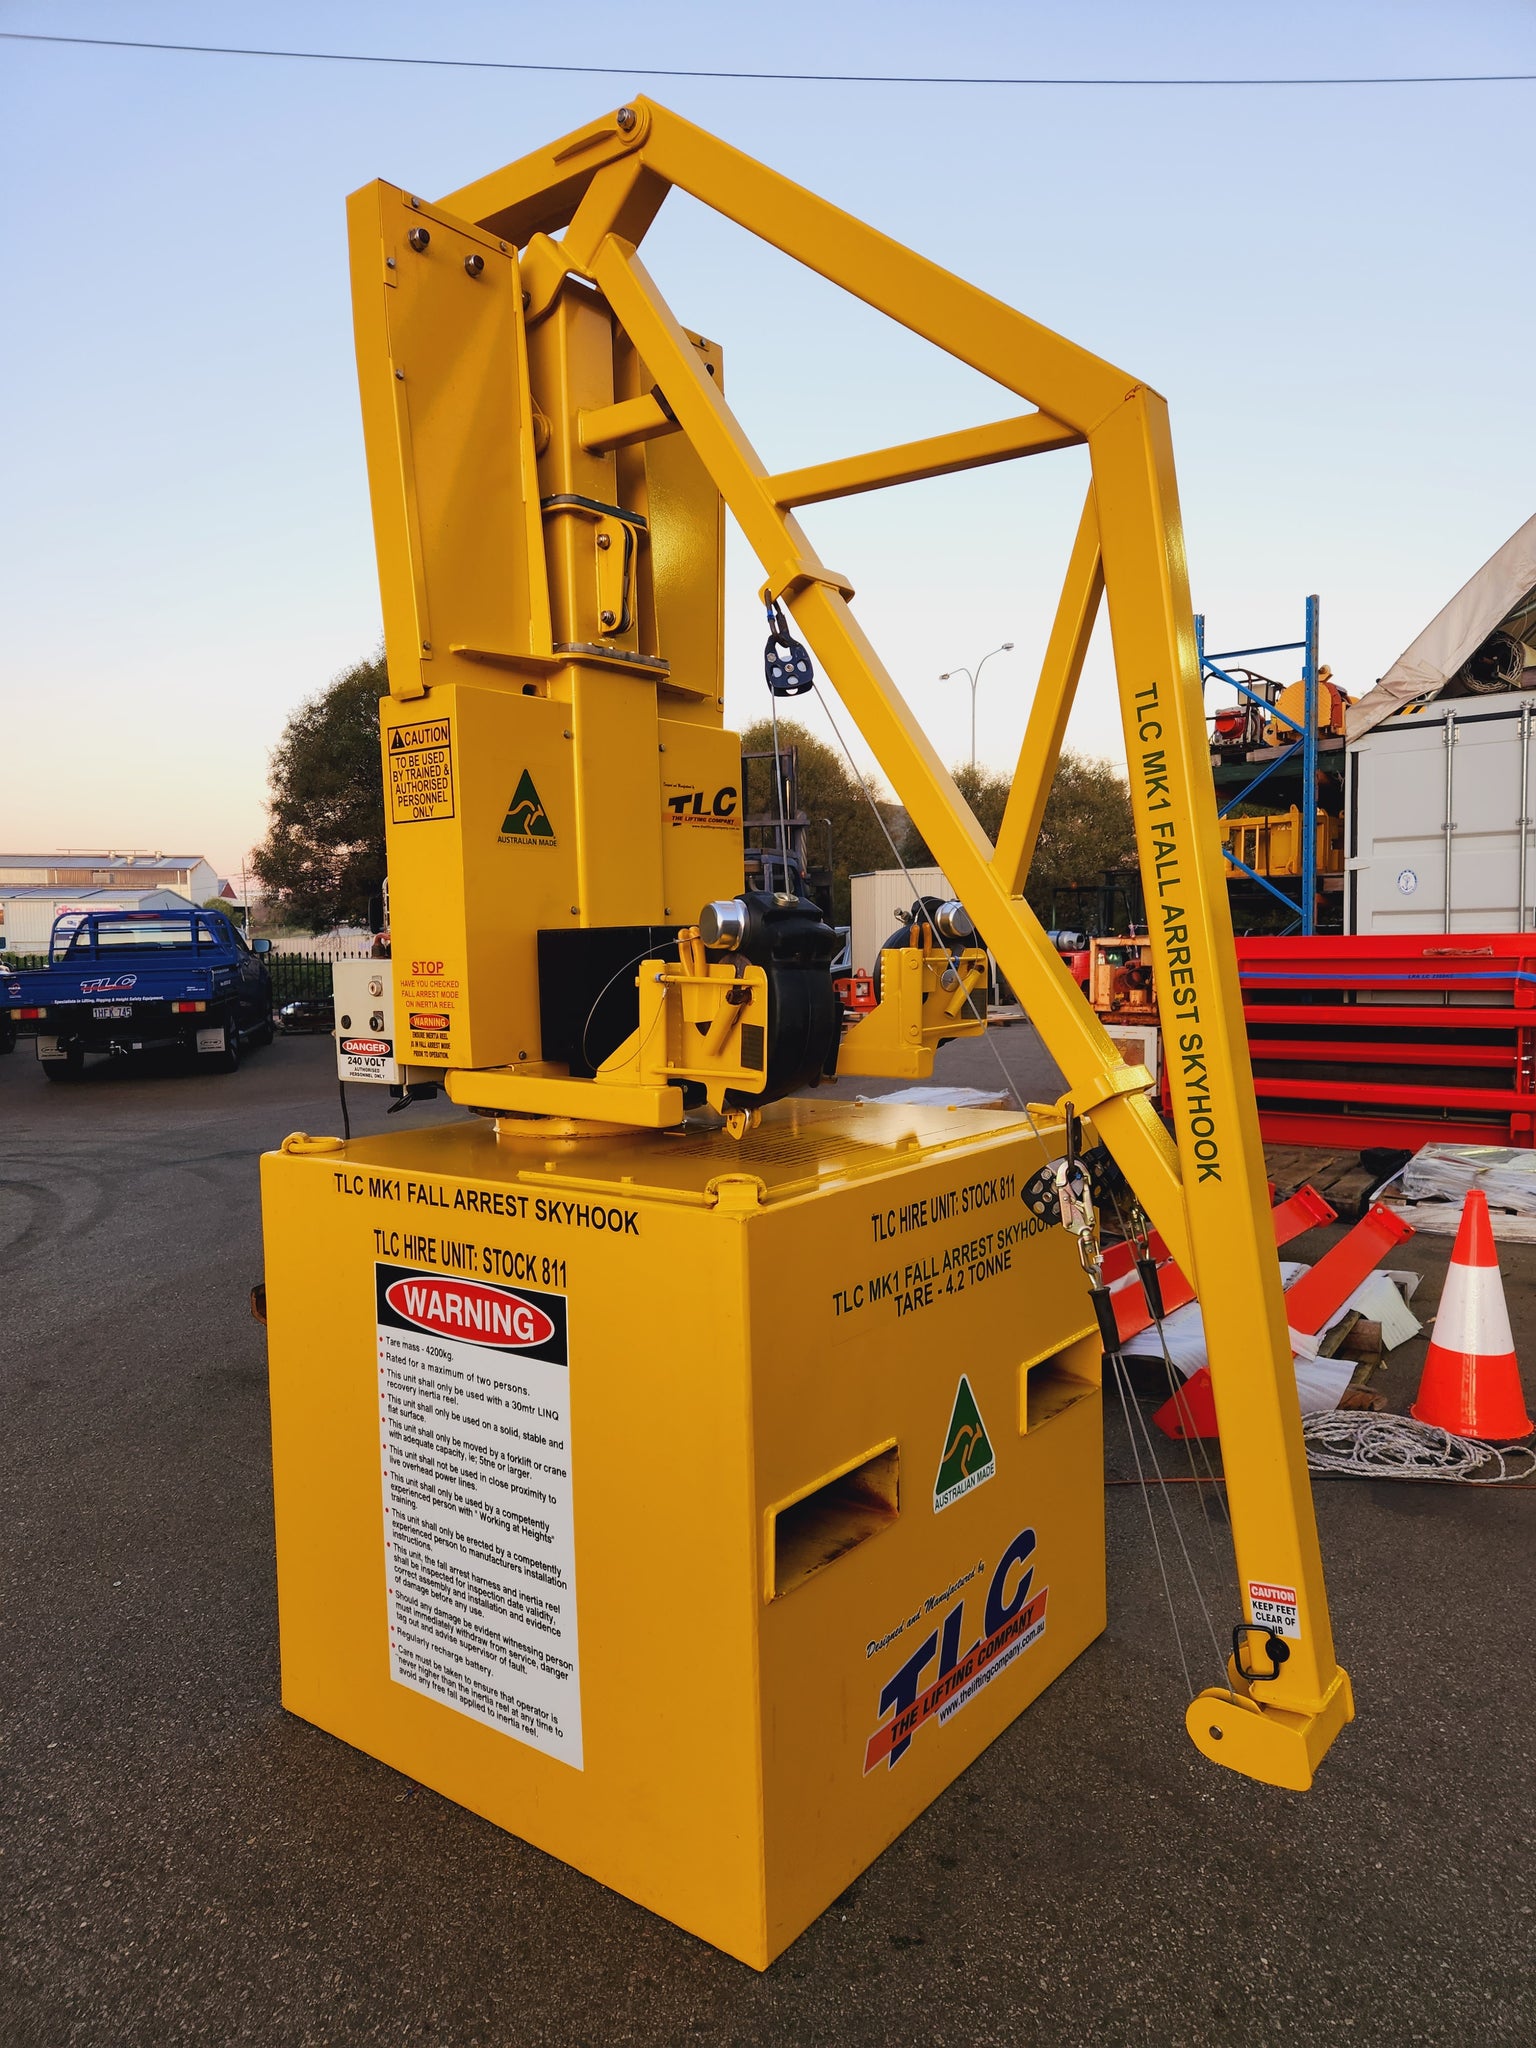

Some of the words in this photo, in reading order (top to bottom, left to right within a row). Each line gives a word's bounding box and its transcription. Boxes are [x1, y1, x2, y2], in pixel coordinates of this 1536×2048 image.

[1135, 682, 1163, 742] TLC
[405, 726, 448, 746] CAUTION
[393, 770, 403, 782] BY
[406, 765, 441, 781] TRAINED
[444, 764, 450, 775] &
[396, 757, 406, 768] TO
[409, 755, 419, 767] BE
[422, 752, 444, 765] USED
[1142, 750, 1172, 811] MK1
[396, 778, 448, 794] AUTHORISED
[398, 791, 448, 807] PERSONNEL
[668, 787, 737, 826] TLC
[413, 805, 434, 818] ONLY
[498, 836, 537, 845] AUSTRALIAN
[539, 838, 557, 847] MADE
[1151, 822, 1181, 897] FALL
[80, 974, 137, 994] TLC
[412, 962, 444, 973] STOP
[1161, 905, 1200, 1023] ARREST
[413, 1017, 446, 1027] WARNING
[346, 1042, 386, 1052] DANGER
[348, 1057, 362, 1065] 240
[364, 1058, 386, 1067] VOLT
[1179, 1034, 1222, 1183] SKYHOOK
[334, 1173, 363, 1196] TLC
[369, 1178, 401, 1201] MK1
[408, 1182, 449, 1208] FALL
[454, 1189, 528, 1218] ARREST
[535, 1199, 640, 1236] SKYHOOK
[871, 1209, 896, 1242] TLC
[900, 1200, 928, 1233] HIRE
[930, 1191, 959, 1223] UNIT:
[962, 1178, 998, 1212] STOCK
[1000, 1174, 1015, 1201] 811
[374, 1229, 399, 1257] TLC
[404, 1234, 437, 1264] HIRE
[441, 1240, 478, 1272] UNIT:
[483, 1246, 538, 1282] STOCK
[542, 1257, 567, 1288] 811
[833, 1284, 864, 1316] TLC
[868, 1270, 899, 1302] MK1
[905, 1256, 939, 1288] FALL
[943, 1234, 994, 1273] ARREST
[894, 1286, 934, 1317] TARE
[946, 1270, 964, 1294] 4.2
[968, 1250, 1012, 1285] TONNE
[403, 1284, 534, 1341] WARNING
[385, 1335, 400, 1347] Tare
[401, 1341, 420, 1352] mass
[425, 1345, 453, 1362] 4200kg.
[385, 1351, 406, 1365] Rated
[408, 1357, 418, 1367] for
[427, 1364, 463, 1378] maximum
[466, 1372, 474, 1381] of
[476, 1374, 491, 1386] two
[493, 1380, 529, 1395] persons.
[386, 1380, 416, 1395] recovery
[418, 1387, 440, 1400] inertia
[442, 1395, 458, 1405] reel.
[386, 1368, 401, 1379] This
[402, 1374, 416, 1383] unit
[417, 1377, 434, 1388] shall
[436, 1382, 452, 1394] only
[454, 1385, 463, 1396] be
[465, 1390, 484, 1401] used
[486, 1395, 502, 1405] with
[504, 1400, 509, 1408] a
[511, 1400, 535, 1414] 30mtr
[537, 1407, 558, 1420] LINQ
[387, 1403, 398, 1414] flat
[399, 1409, 425, 1422] surface.
[387, 1392, 401, 1404] This
[402, 1399, 415, 1408] unit
[416, 1402, 433, 1412] shall
[434, 1408, 449, 1420] only
[451, 1410, 460, 1421] be
[462, 1415, 480, 1426] used
[481, 1420, 491, 1429] on
[499, 1425, 520, 1438] solid,
[522, 1432, 546, 1445] stable
[548, 1439, 563, 1450] and
[389, 1444, 403, 1456] This
[404, 1451, 417, 1460] unit
[418, 1454, 434, 1466] shall
[436, 1460, 448, 1470] not
[449, 1462, 458, 1473] be
[460, 1468, 478, 1479] used
[479, 1472, 486, 1482] in
[488, 1476, 508, 1489] close
[510, 1484, 546, 1503] proximity
[548, 1493, 556, 1504] to
[935, 1479, 976, 1511] AUSTRALIAN
[976, 1463, 994, 1484] MADE
[865, 1620, 905, 1660] Designed
[906, 1608, 921, 1628] and
[924, 1568, 976, 1614] Manufactured
[977, 1559, 985, 1574] by
[1251, 1586, 1294, 1602] CAUTION
[1252, 1600, 1274, 1612] KEEP
[1276, 1605, 1296, 1615] FEET
[1256, 1612, 1282, 1624] CLEAR
[1285, 1618, 1296, 1627] OF
[396, 1626, 429, 1649] Regularly
[431, 1643, 463, 1662] recharge
[464, 1656, 493, 1676] battery.
[878, 1527, 1036, 1770] TLC
[940, 1621, 1044, 1722] www.theliftingcompany.com.au
[891, 1704, 919, 1742] THE
[923, 1661, 973, 1712] LIFTING
[977, 1606, 1034, 1666] COMPANY
